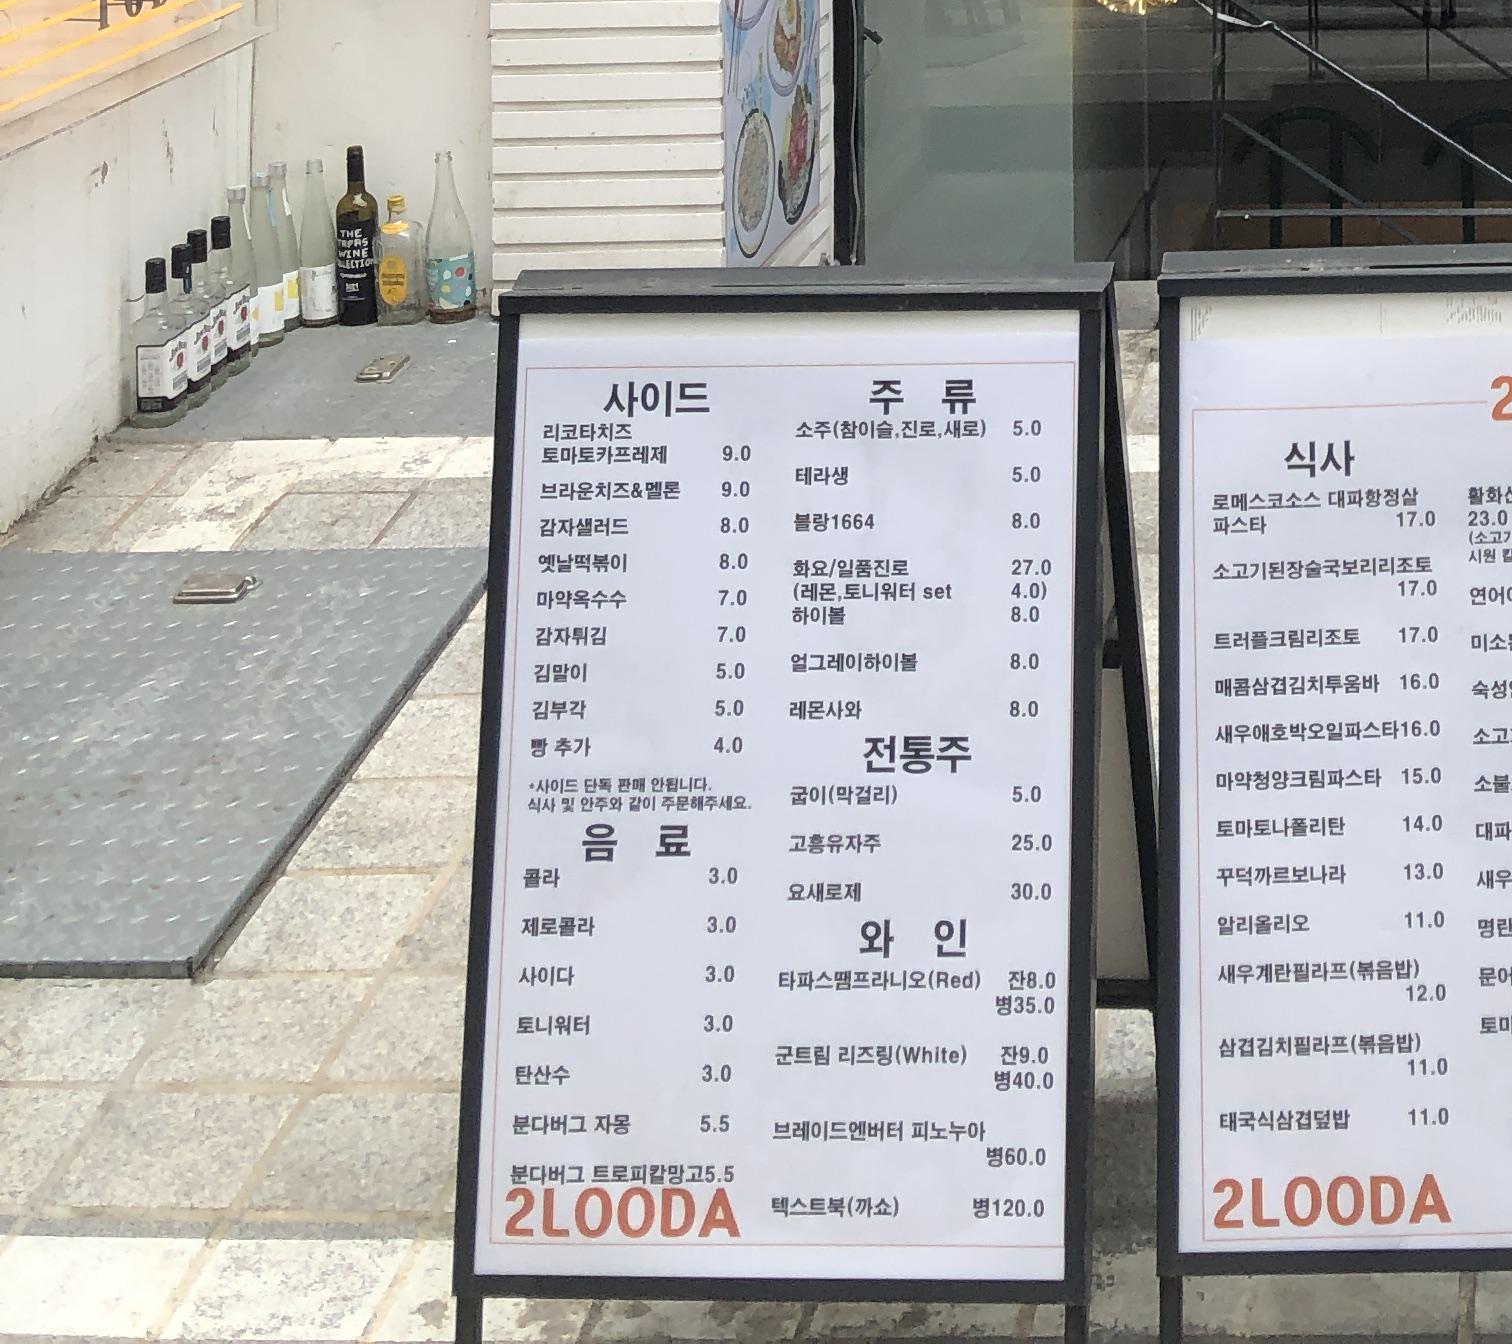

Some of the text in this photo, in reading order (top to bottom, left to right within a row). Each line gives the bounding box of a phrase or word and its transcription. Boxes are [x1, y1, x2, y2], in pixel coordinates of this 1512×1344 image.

[340, 228, 363, 238] THE
[603, 381, 709, 417] 사이드
[544, 423, 632, 442] 리코타치즈
[1013, 420, 1041, 436] 5.0
[542, 445, 751, 465] 토마토카프레제 9.0
[1284, 440, 1355, 477] 식사
[796, 466, 1040, 485] 테라생 5.0
[540, 481, 750, 501] 브라운치즈&멜론 9.0
[1212, 487, 1418, 511] 로메스코소스 대파항정살
[540, 517, 749, 537] 감자샐러드 8.0
[794, 513, 1040, 532] 블랑1664 8.0
[1213, 511, 1435, 535] 파스타 17.0
[538, 553, 748, 573] 옛날떡볶이 8.0
[793, 559, 1051, 578] 화요/일품진로 27.0
[1213, 557, 1437, 596] 소고기된장술국보리리조토 17.0
[537, 590, 747, 609] 마약옥수수 7.0
[794, 581, 1046, 602] (레몬,토니워터 set 4.0)
[792, 606, 1039, 625] 하이볼 8.0
[536, 626, 745, 646] 감자튀김 7.0
[1214, 626, 1438, 650] 트러플크림리조토 17.0
[791, 653, 1039, 672] 얼그레이하이볼 8.0
[535, 663, 745, 683] 김말이 5.0
[533, 700, 743, 720] 김부각 5.0
[790, 700, 1038, 720] 레몬사와 8.0
[531, 737, 742, 757] 빵 추가 4.0
[864, 736, 971, 774] 전통주
[584, 778, 612, 793] 단독
[618, 778, 645, 793] 판매
[1216, 767, 1441, 791] 마약청양크림파스타 15.0
[789, 834, 1052, 854] 고흥유자주 25.0
[523, 867, 737, 888] 콜라 3.0
[788, 883, 1051, 902] 요새로제 30.0
[522, 916, 736, 936] 제로콜라 3.0
[519, 965, 734, 986] 사이다 3.0
[1008, 970, 1055, 990] 잔8.0
[996, 995, 1054, 1016] 병35.0
[517, 1015, 733, 1035] 토니워터 3.0
[515, 1064, 731, 1085] 탄산수 3.0
[513, 1114, 729, 1135] 분다버그 자몽 5.5
[1220, 1108, 1448, 1132] 태국식삼겹덮밥 11.0
[772, 1196, 1044, 1218] 텍스트북(까쇼) 병120.0
[1213, 1174, 1451, 1228] 2LOODA
[505, 1187, 740, 1238] 2LOODA
